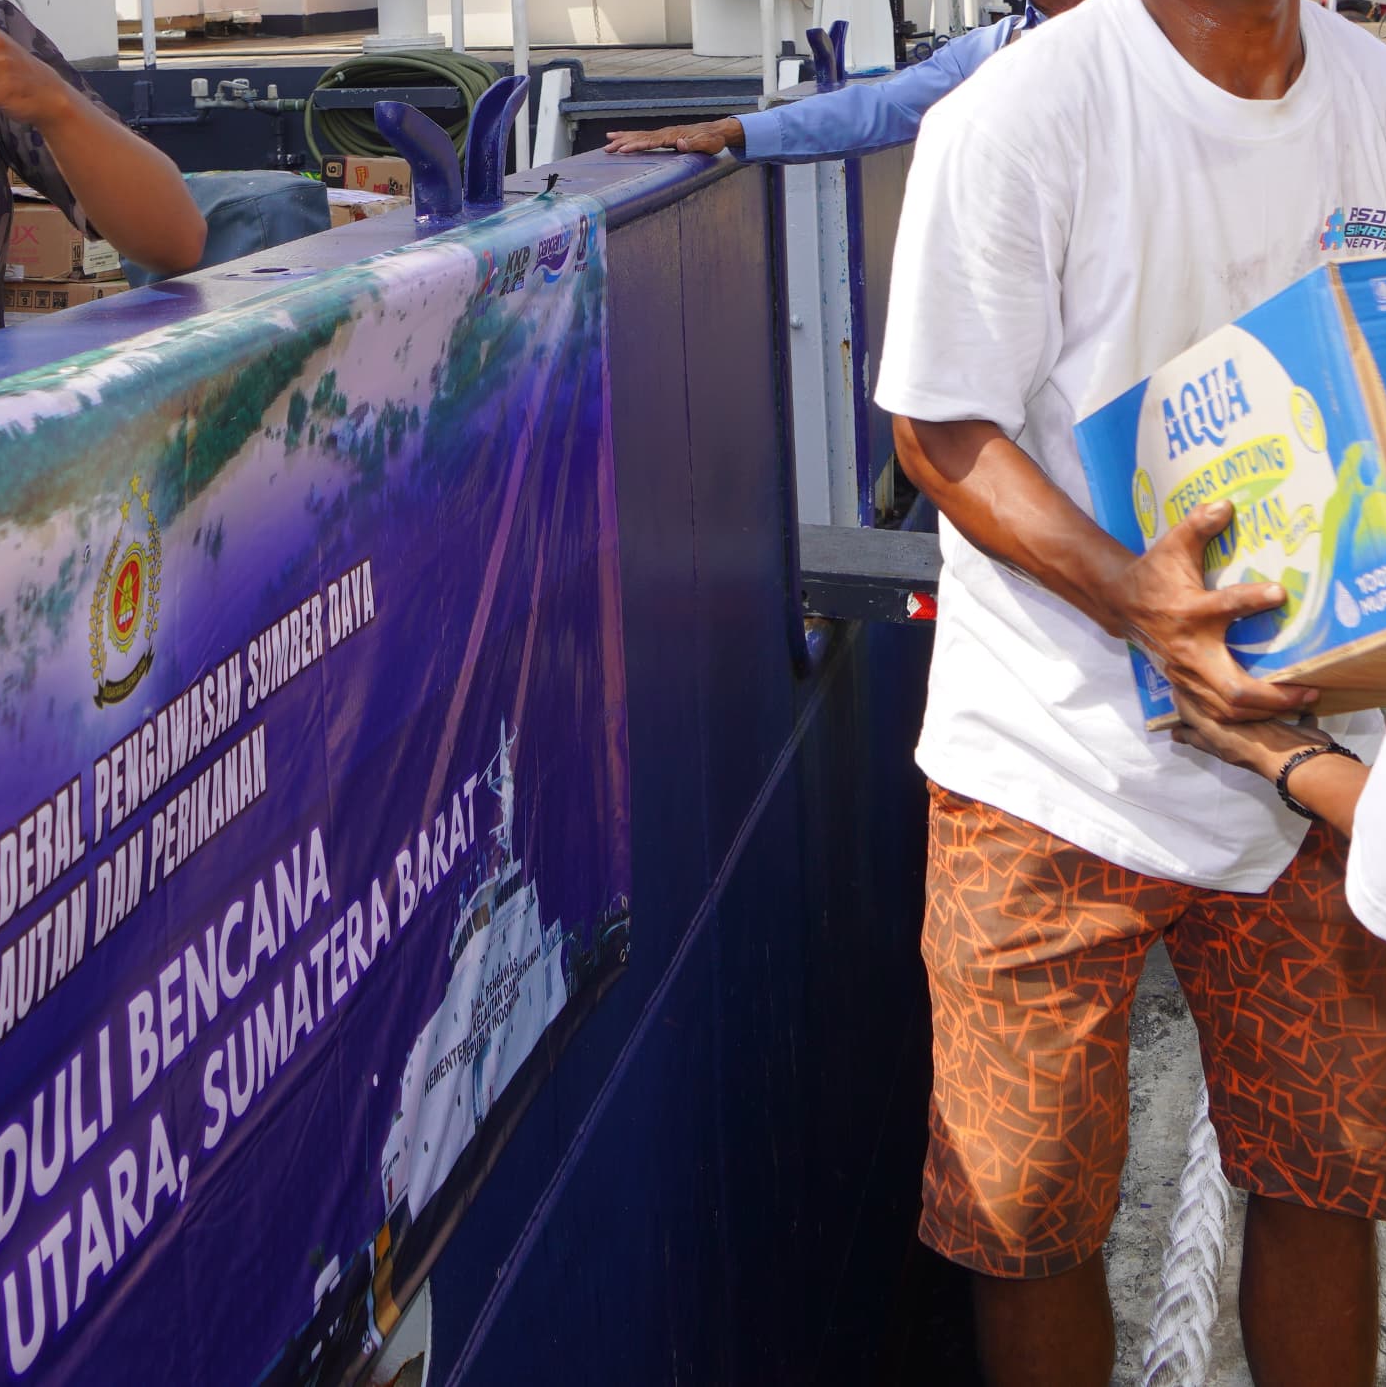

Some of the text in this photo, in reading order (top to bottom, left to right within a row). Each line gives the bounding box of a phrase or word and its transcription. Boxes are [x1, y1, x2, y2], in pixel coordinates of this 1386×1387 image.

[505, 245, 531, 276] KKP
[1161, 357, 1252, 461] AQUA
[1217, 438, 1286, 490] UNTUNG
[94, 654, 241, 843] PENGAWASAN
[247, 612, 323, 709] SUMBER
[329, 561, 376, 663] DAYA
[94, 832, 143, 946] DAN
[149, 725, 267, 891] PERIKANAN
[3, 1113, 191, 1375] UTARA,
[204, 896, 390, 1149] SUMATERA
[396, 773, 479, 930] BARAT
[127, 828, 332, 1102] BENCANA
